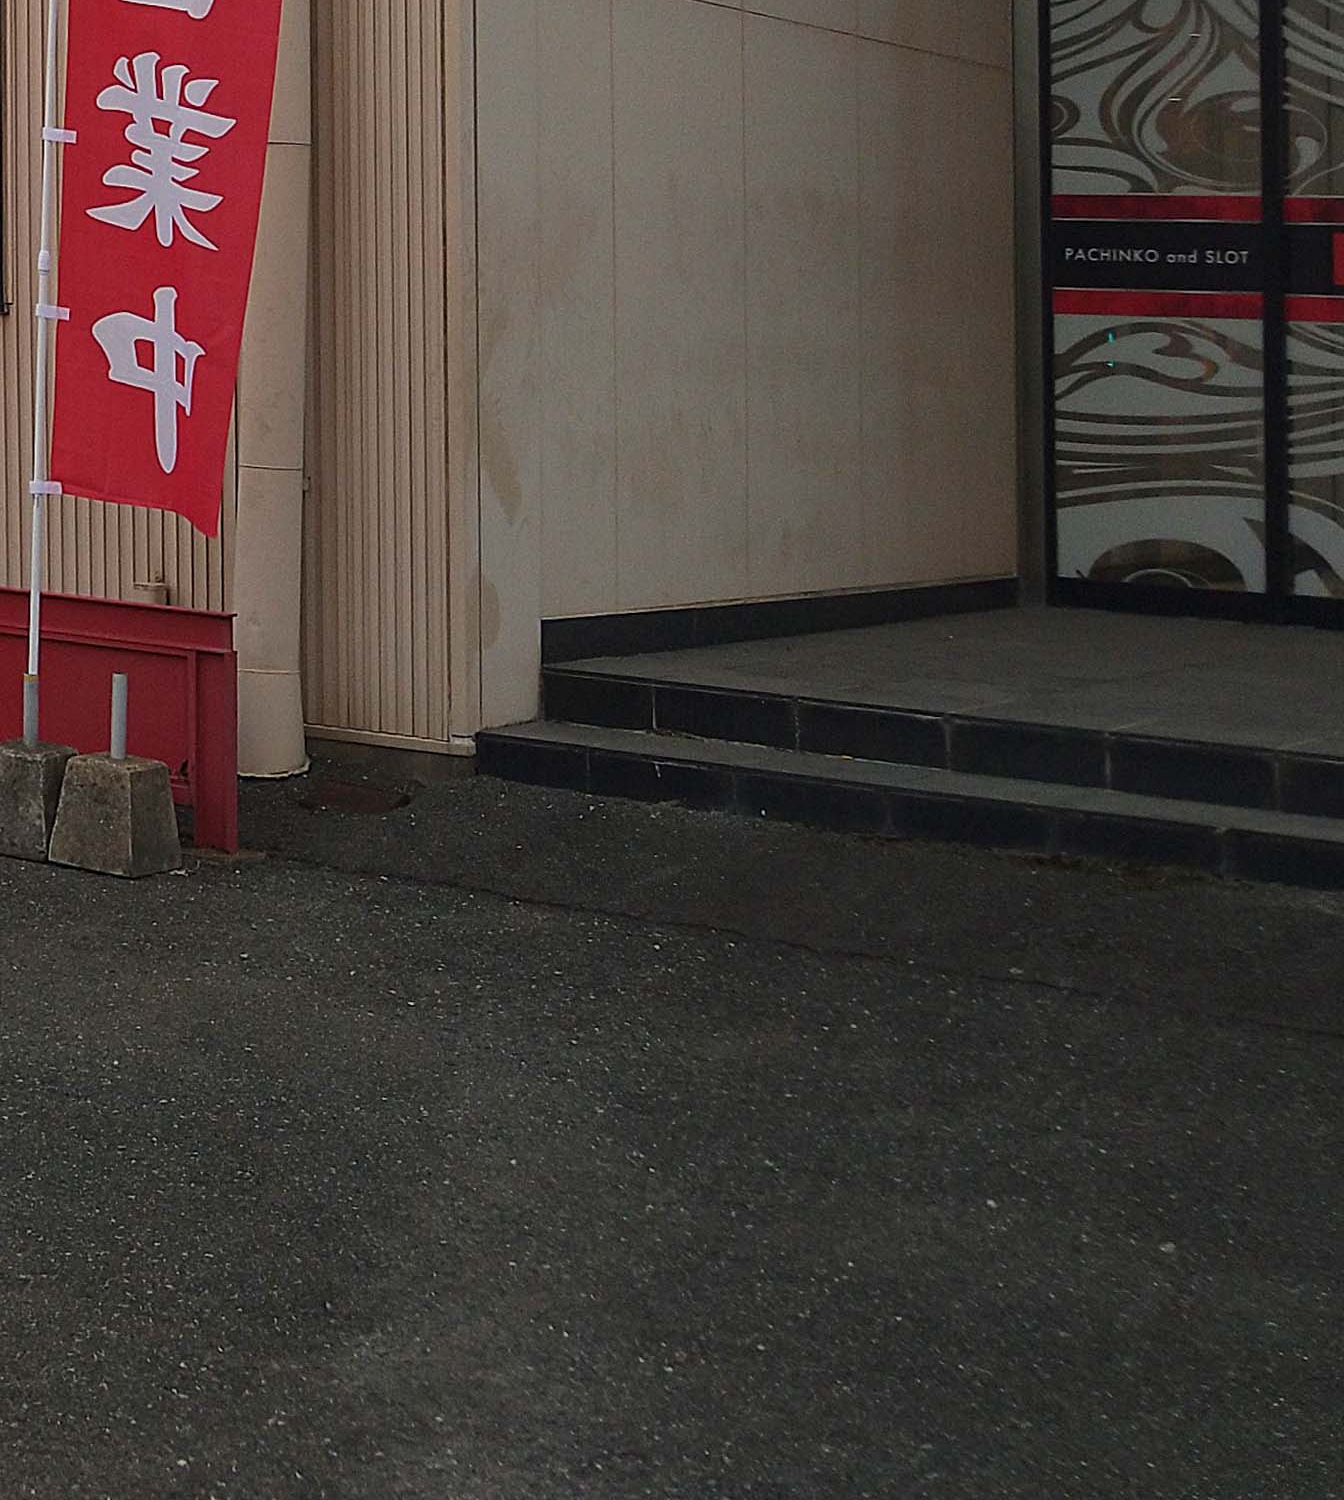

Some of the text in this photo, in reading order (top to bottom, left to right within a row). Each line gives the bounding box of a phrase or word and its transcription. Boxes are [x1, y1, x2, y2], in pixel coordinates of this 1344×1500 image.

[1064, 247, 1250, 265] PACHINKO and SLOT
